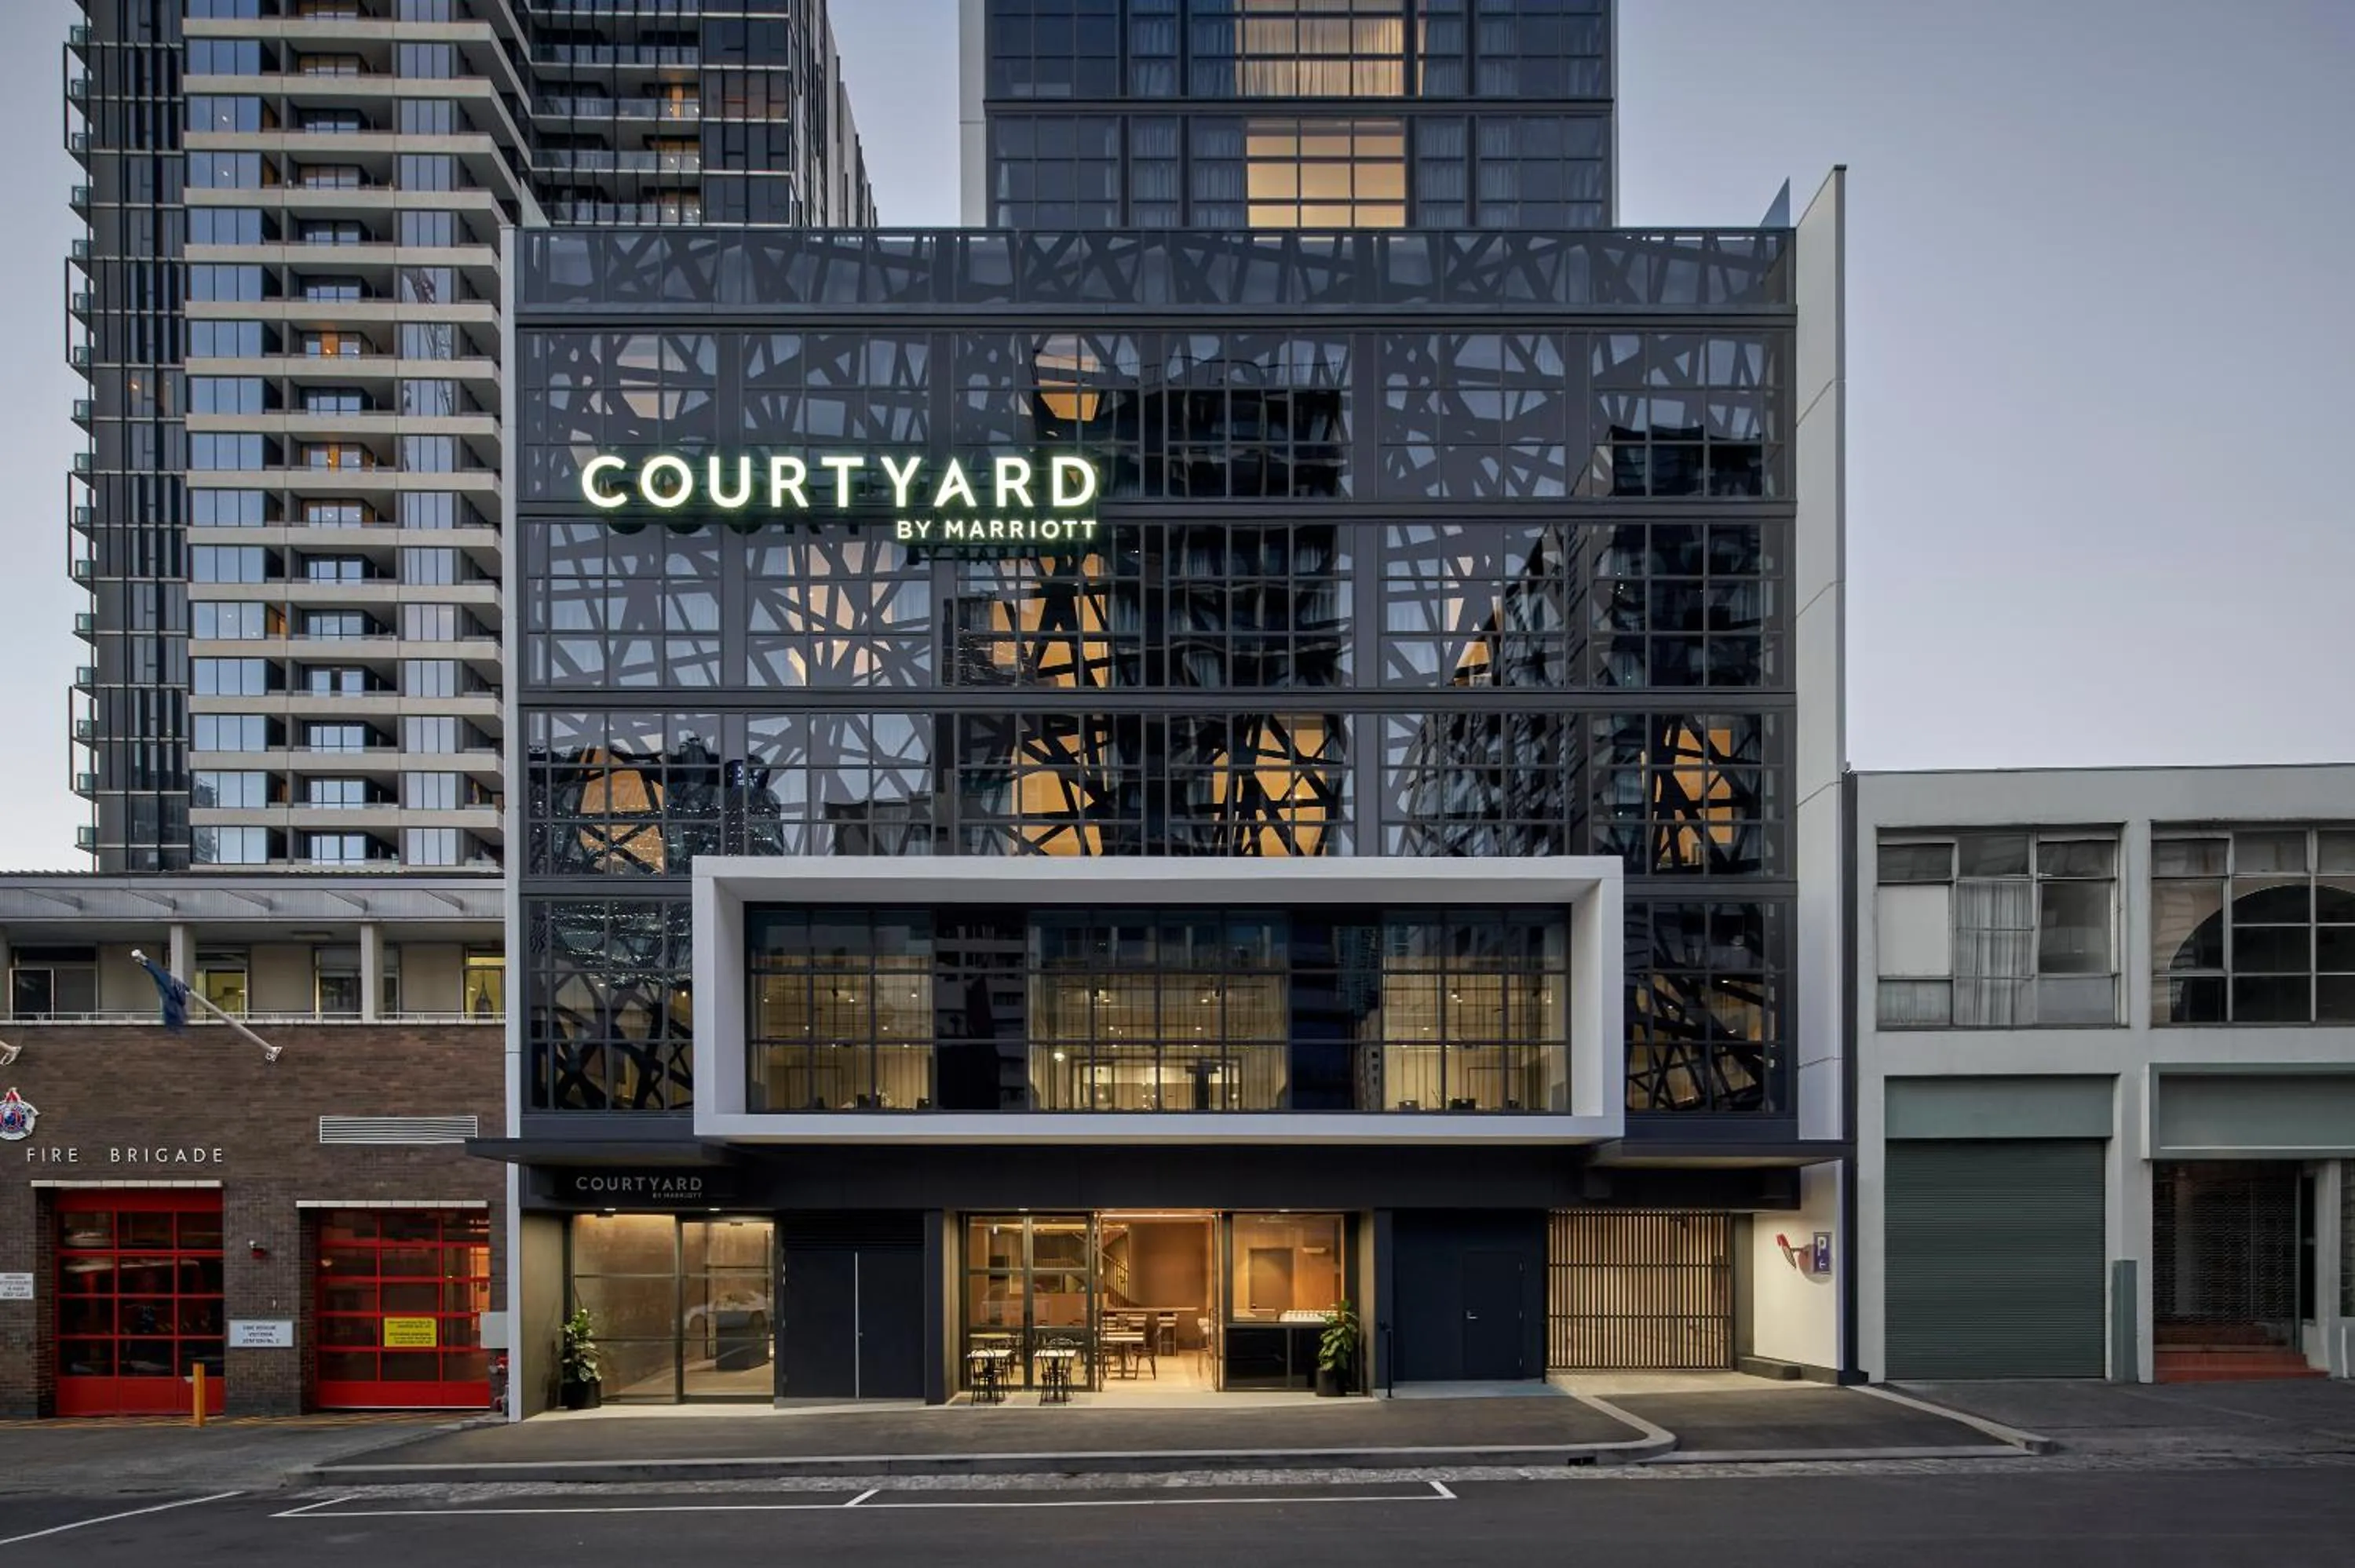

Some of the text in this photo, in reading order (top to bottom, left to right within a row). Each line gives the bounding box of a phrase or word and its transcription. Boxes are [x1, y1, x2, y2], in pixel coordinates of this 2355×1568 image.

[581, 455, 1096, 508] COURTYARD
[896, 520, 1097, 540] BY MARRIOTT
[26, 1147, 223, 1162] FIRE BRIGADE
[575, 1176, 703, 1191] COURTYARD
[1817, 1236, 1827, 1256] P
